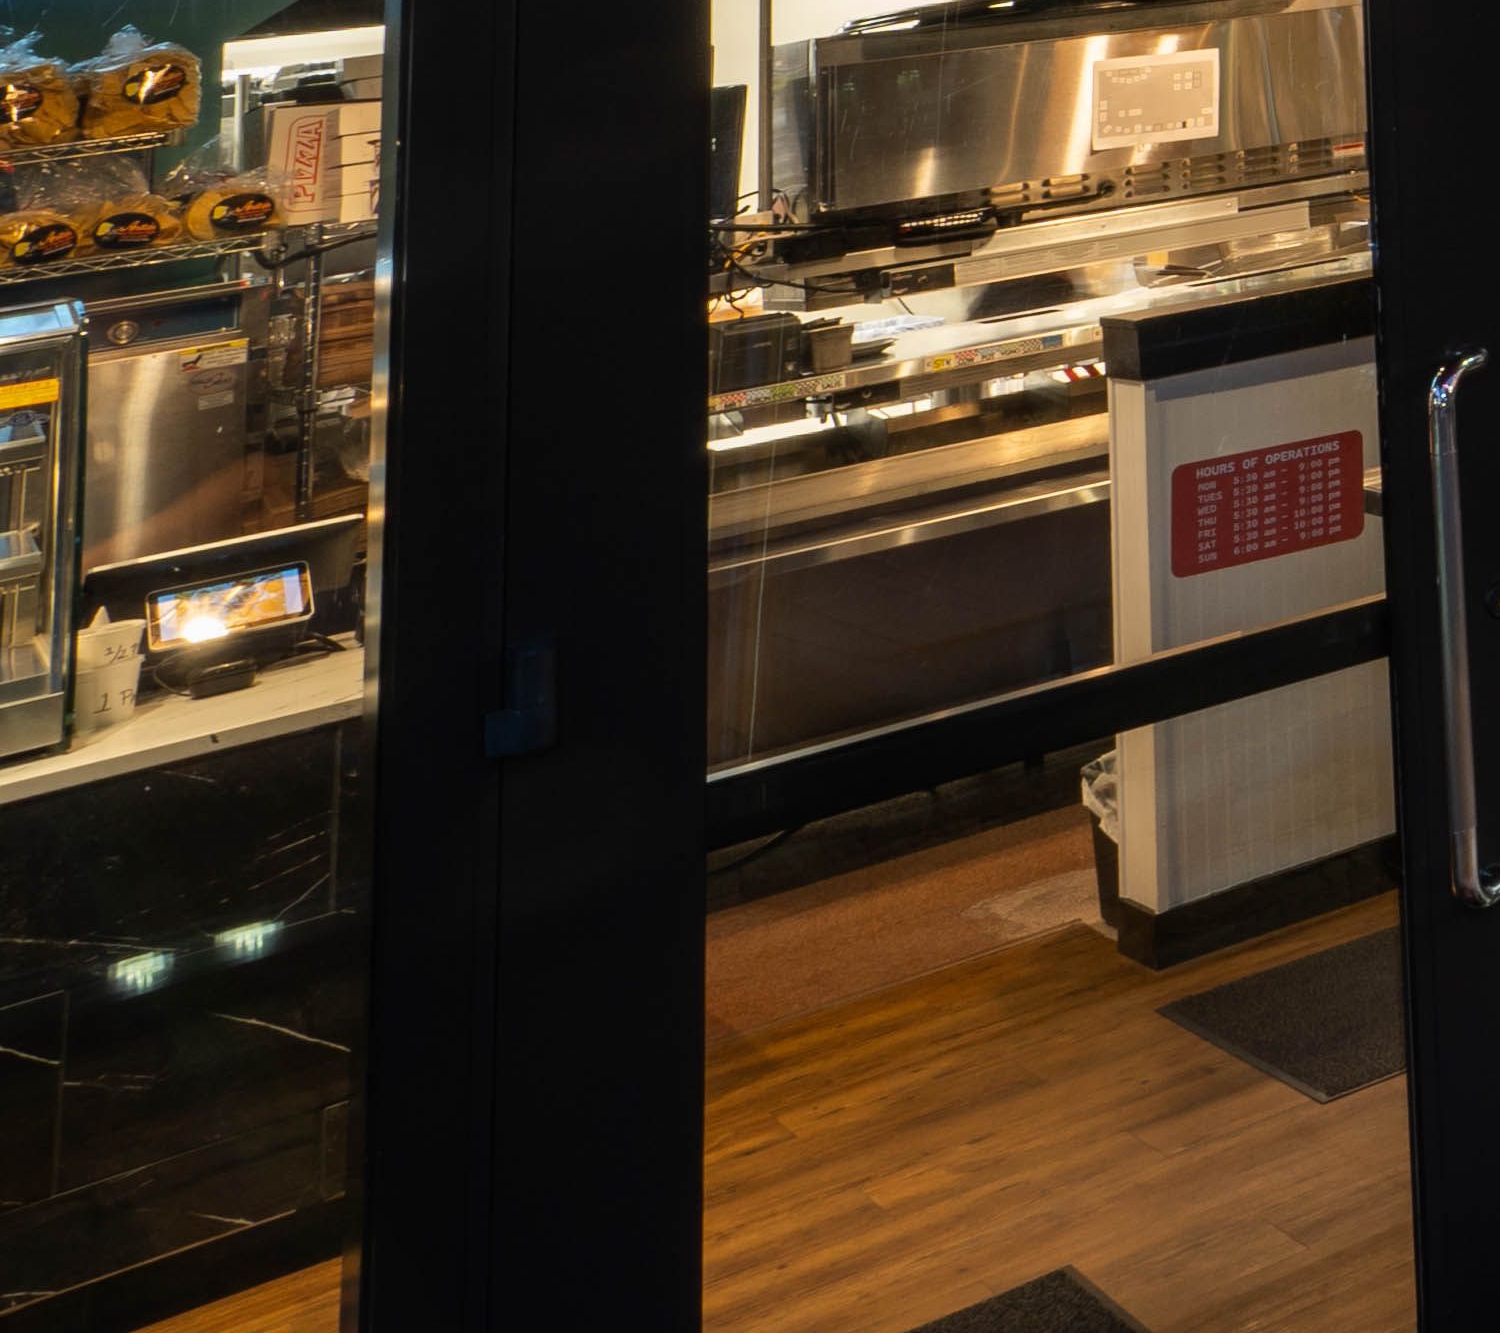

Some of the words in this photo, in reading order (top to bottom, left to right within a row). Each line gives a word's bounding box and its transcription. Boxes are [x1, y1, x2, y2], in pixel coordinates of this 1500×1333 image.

[1195, 461, 1236, 480] HOURS
[1242, 456, 1259, 469] OF
[1265, 440, 1341, 466] OPERATIONS
[1197, 491, 1223, 503] TUES
[1197, 504, 1217, 516] WED
[1198, 516, 1217, 527] THU
[1198, 528, 1217, 539] FRI
[1198, 540, 1217, 552] SAT
